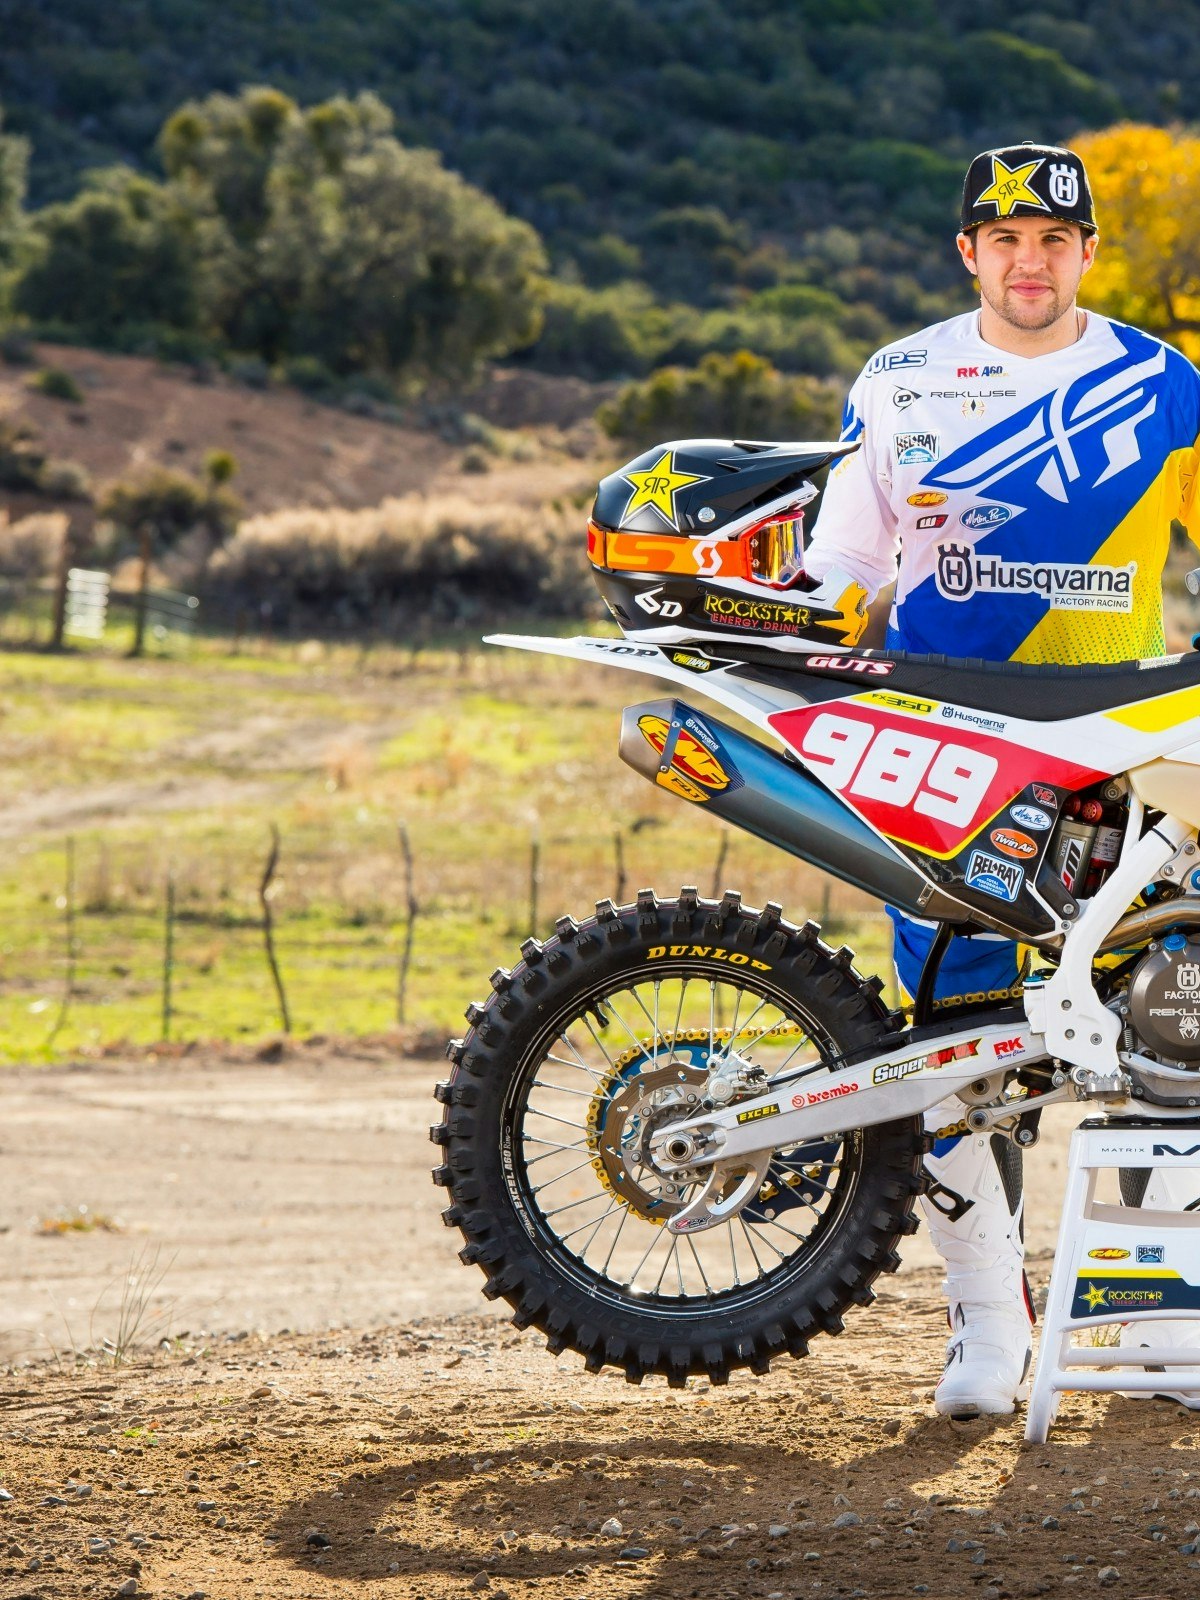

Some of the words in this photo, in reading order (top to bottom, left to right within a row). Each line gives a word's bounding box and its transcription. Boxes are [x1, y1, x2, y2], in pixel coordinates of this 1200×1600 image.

[865, 349, 928, 379] WPS
[957, 367, 980, 378] RK
[981, 365, 1004, 377] A60
[929, 390, 1017, 398] REKLUSE
[907, 492, 948, 506] FMF
[976, 560, 1130, 594] Husqvarna
[1054, 597, 1096, 607] FACTORY
[1096, 599, 1129, 608] RACING
[712, 613, 759, 627] ENERGY
[763, 621, 799, 634] DRINK
[806, 656, 893, 675] GUTS
[872, 693, 887, 701] FX
[886, 696, 932, 713] 350
[953, 710, 1006, 729] Husqvarna
[691, 723, 719, 751] Husqvarna
[801, 712, 999, 829] 989
[995, 833, 1018, 849] Twin
[1018, 843, 1035, 854] Air
[647, 946, 774, 972] DUNLOP
[993, 1036, 1025, 1056] RK
[807, 1083, 859, 1104] brembo
[739, 1105, 778, 1122] EXCEL
[503, 1150, 513, 1171] A60
[506, 1171, 524, 1210] EXCEL
